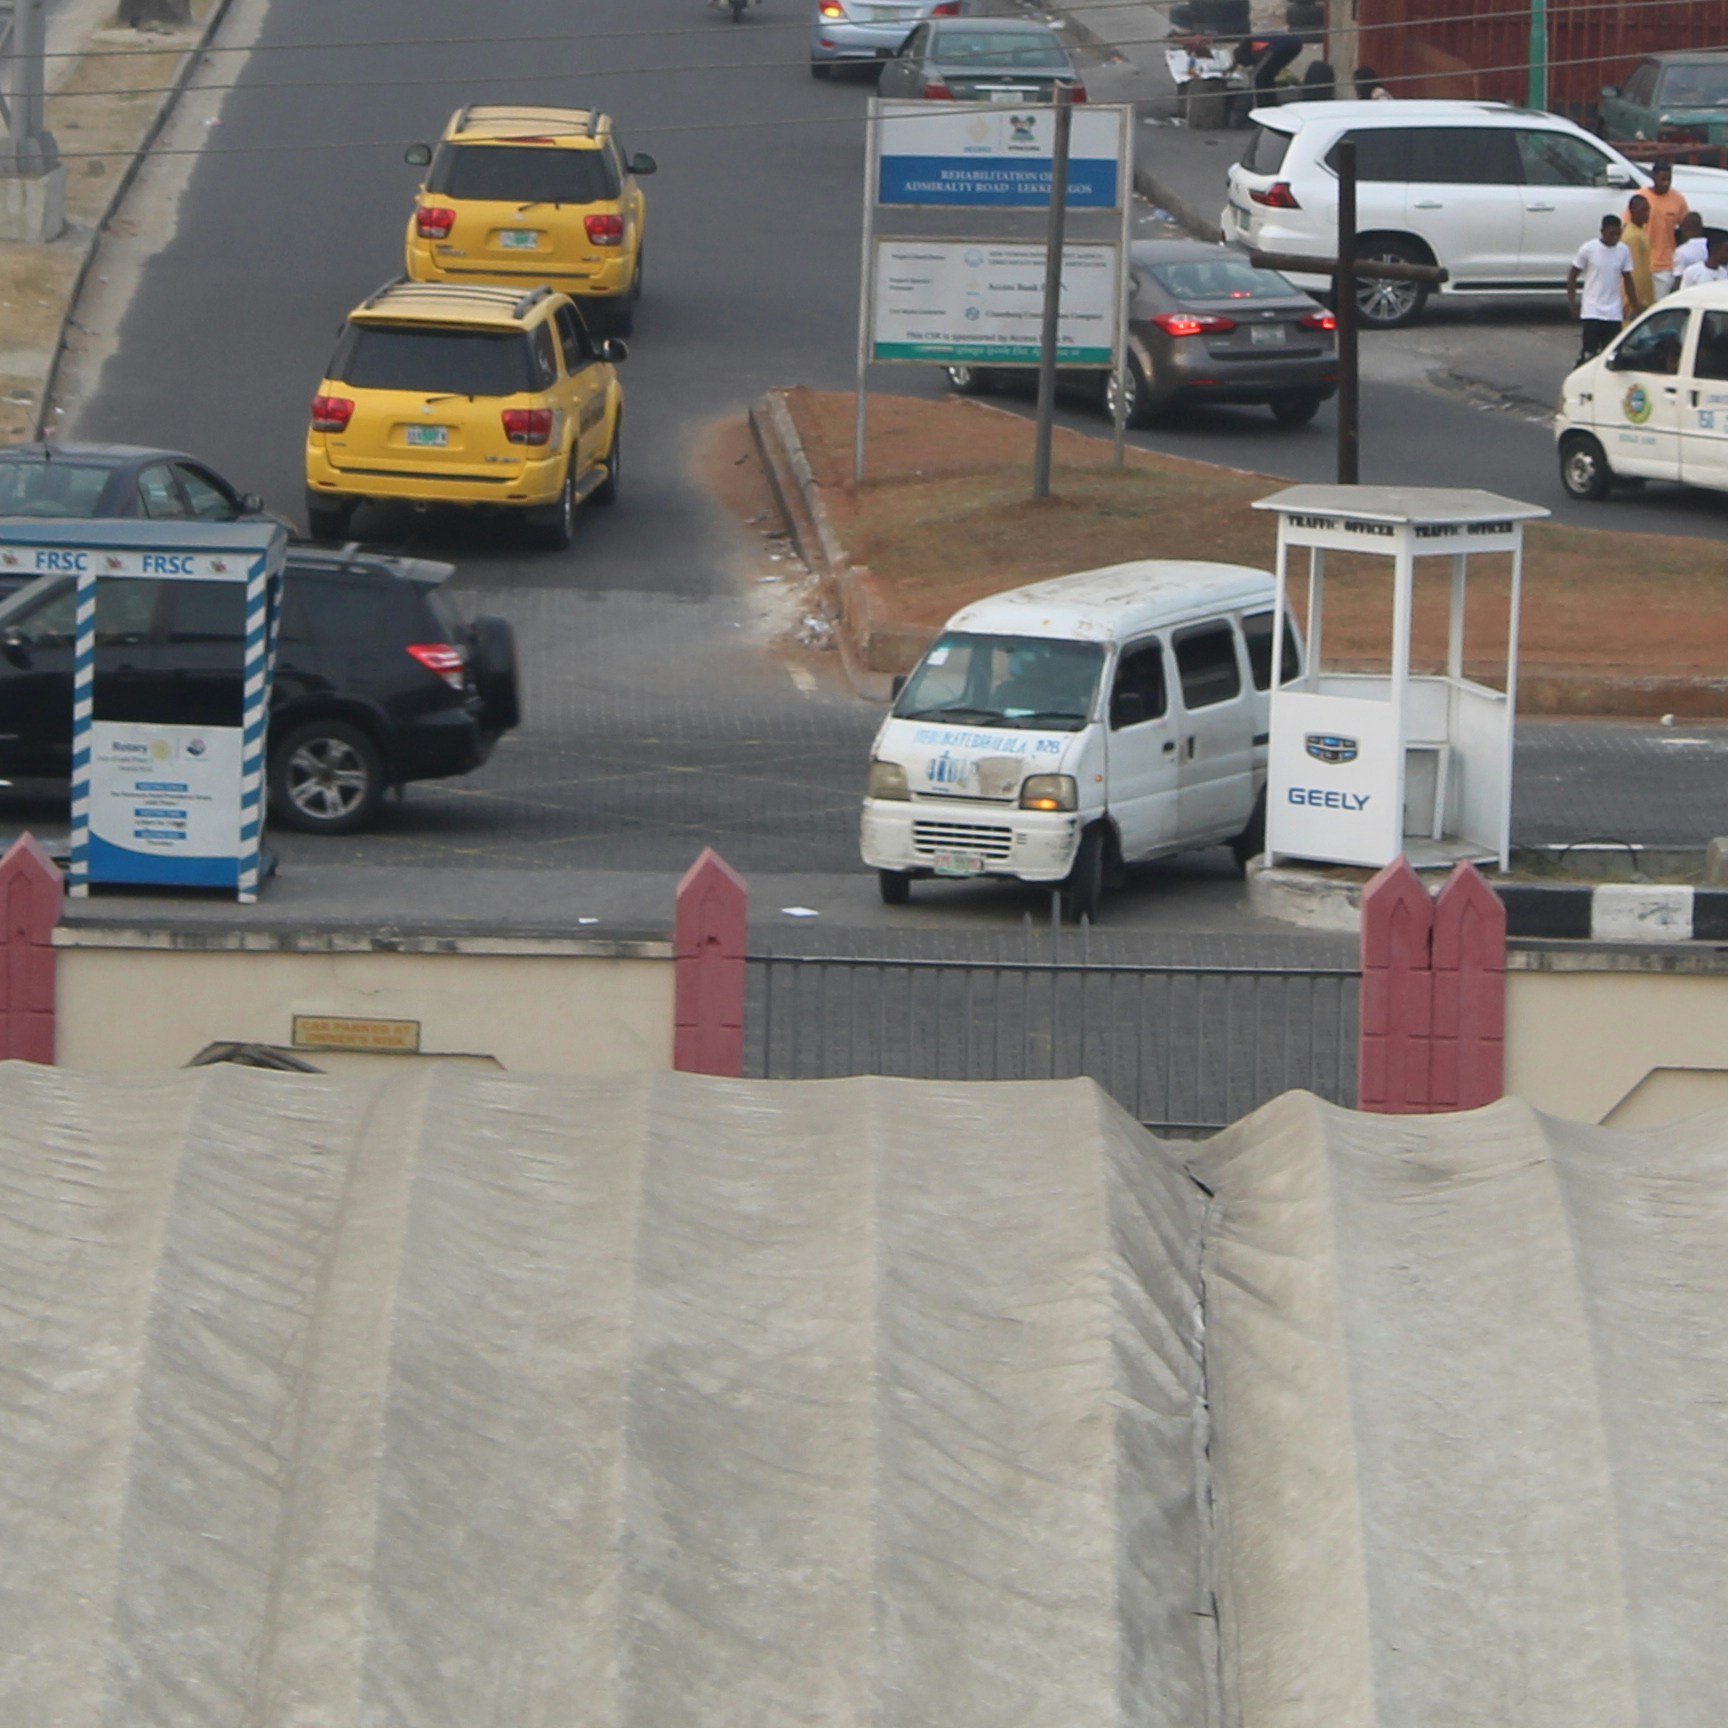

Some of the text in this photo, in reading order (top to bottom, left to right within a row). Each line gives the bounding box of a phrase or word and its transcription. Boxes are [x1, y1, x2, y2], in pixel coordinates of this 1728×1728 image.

[940, 170, 1039, 181] REHABILITATION
[904, 181, 973, 192] ADMIRALTY
[975, 182, 1009, 193] ROAD
[1288, 515, 1395, 537] TRAFFIC OFFICER
[1414, 521, 1514, 538] TRAFFIC OFFICER
[36, 551, 88, 571] FRSC
[143, 555, 195, 574] FRSC
[112, 741, 148, 754] Rotary
[1288, 787, 1370, 811] GEELY
[302, 1021, 411, 1034] CAR PARKED AT
[373, 1036, 407, 1046] RISK
